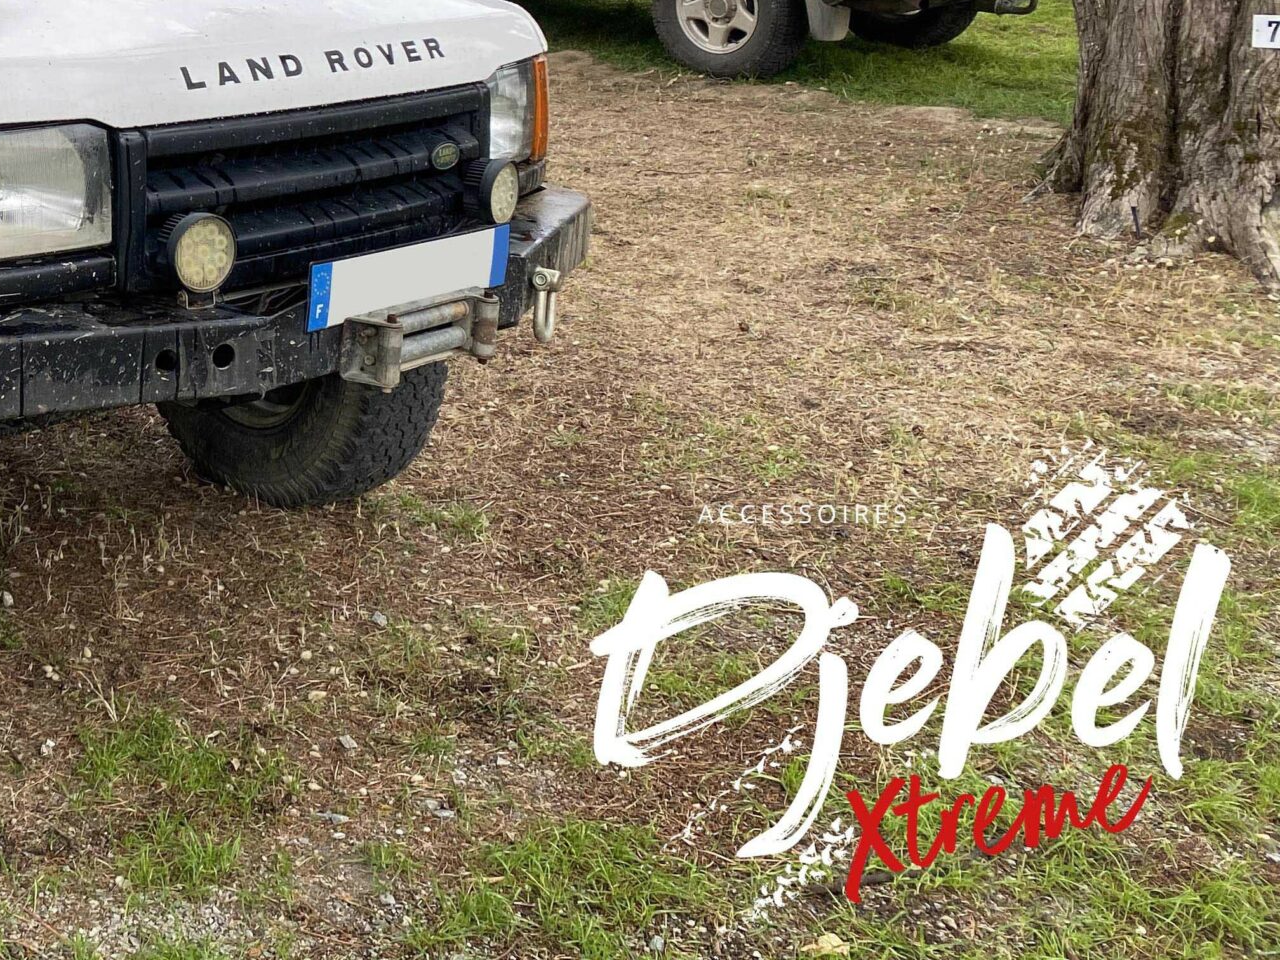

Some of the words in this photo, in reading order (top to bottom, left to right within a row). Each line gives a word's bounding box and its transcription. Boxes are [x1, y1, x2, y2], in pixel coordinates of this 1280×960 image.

[180, 53, 304, 91] LAND
[324, 37, 446, 74] ROVER
[315, 303, 324, 319] F
